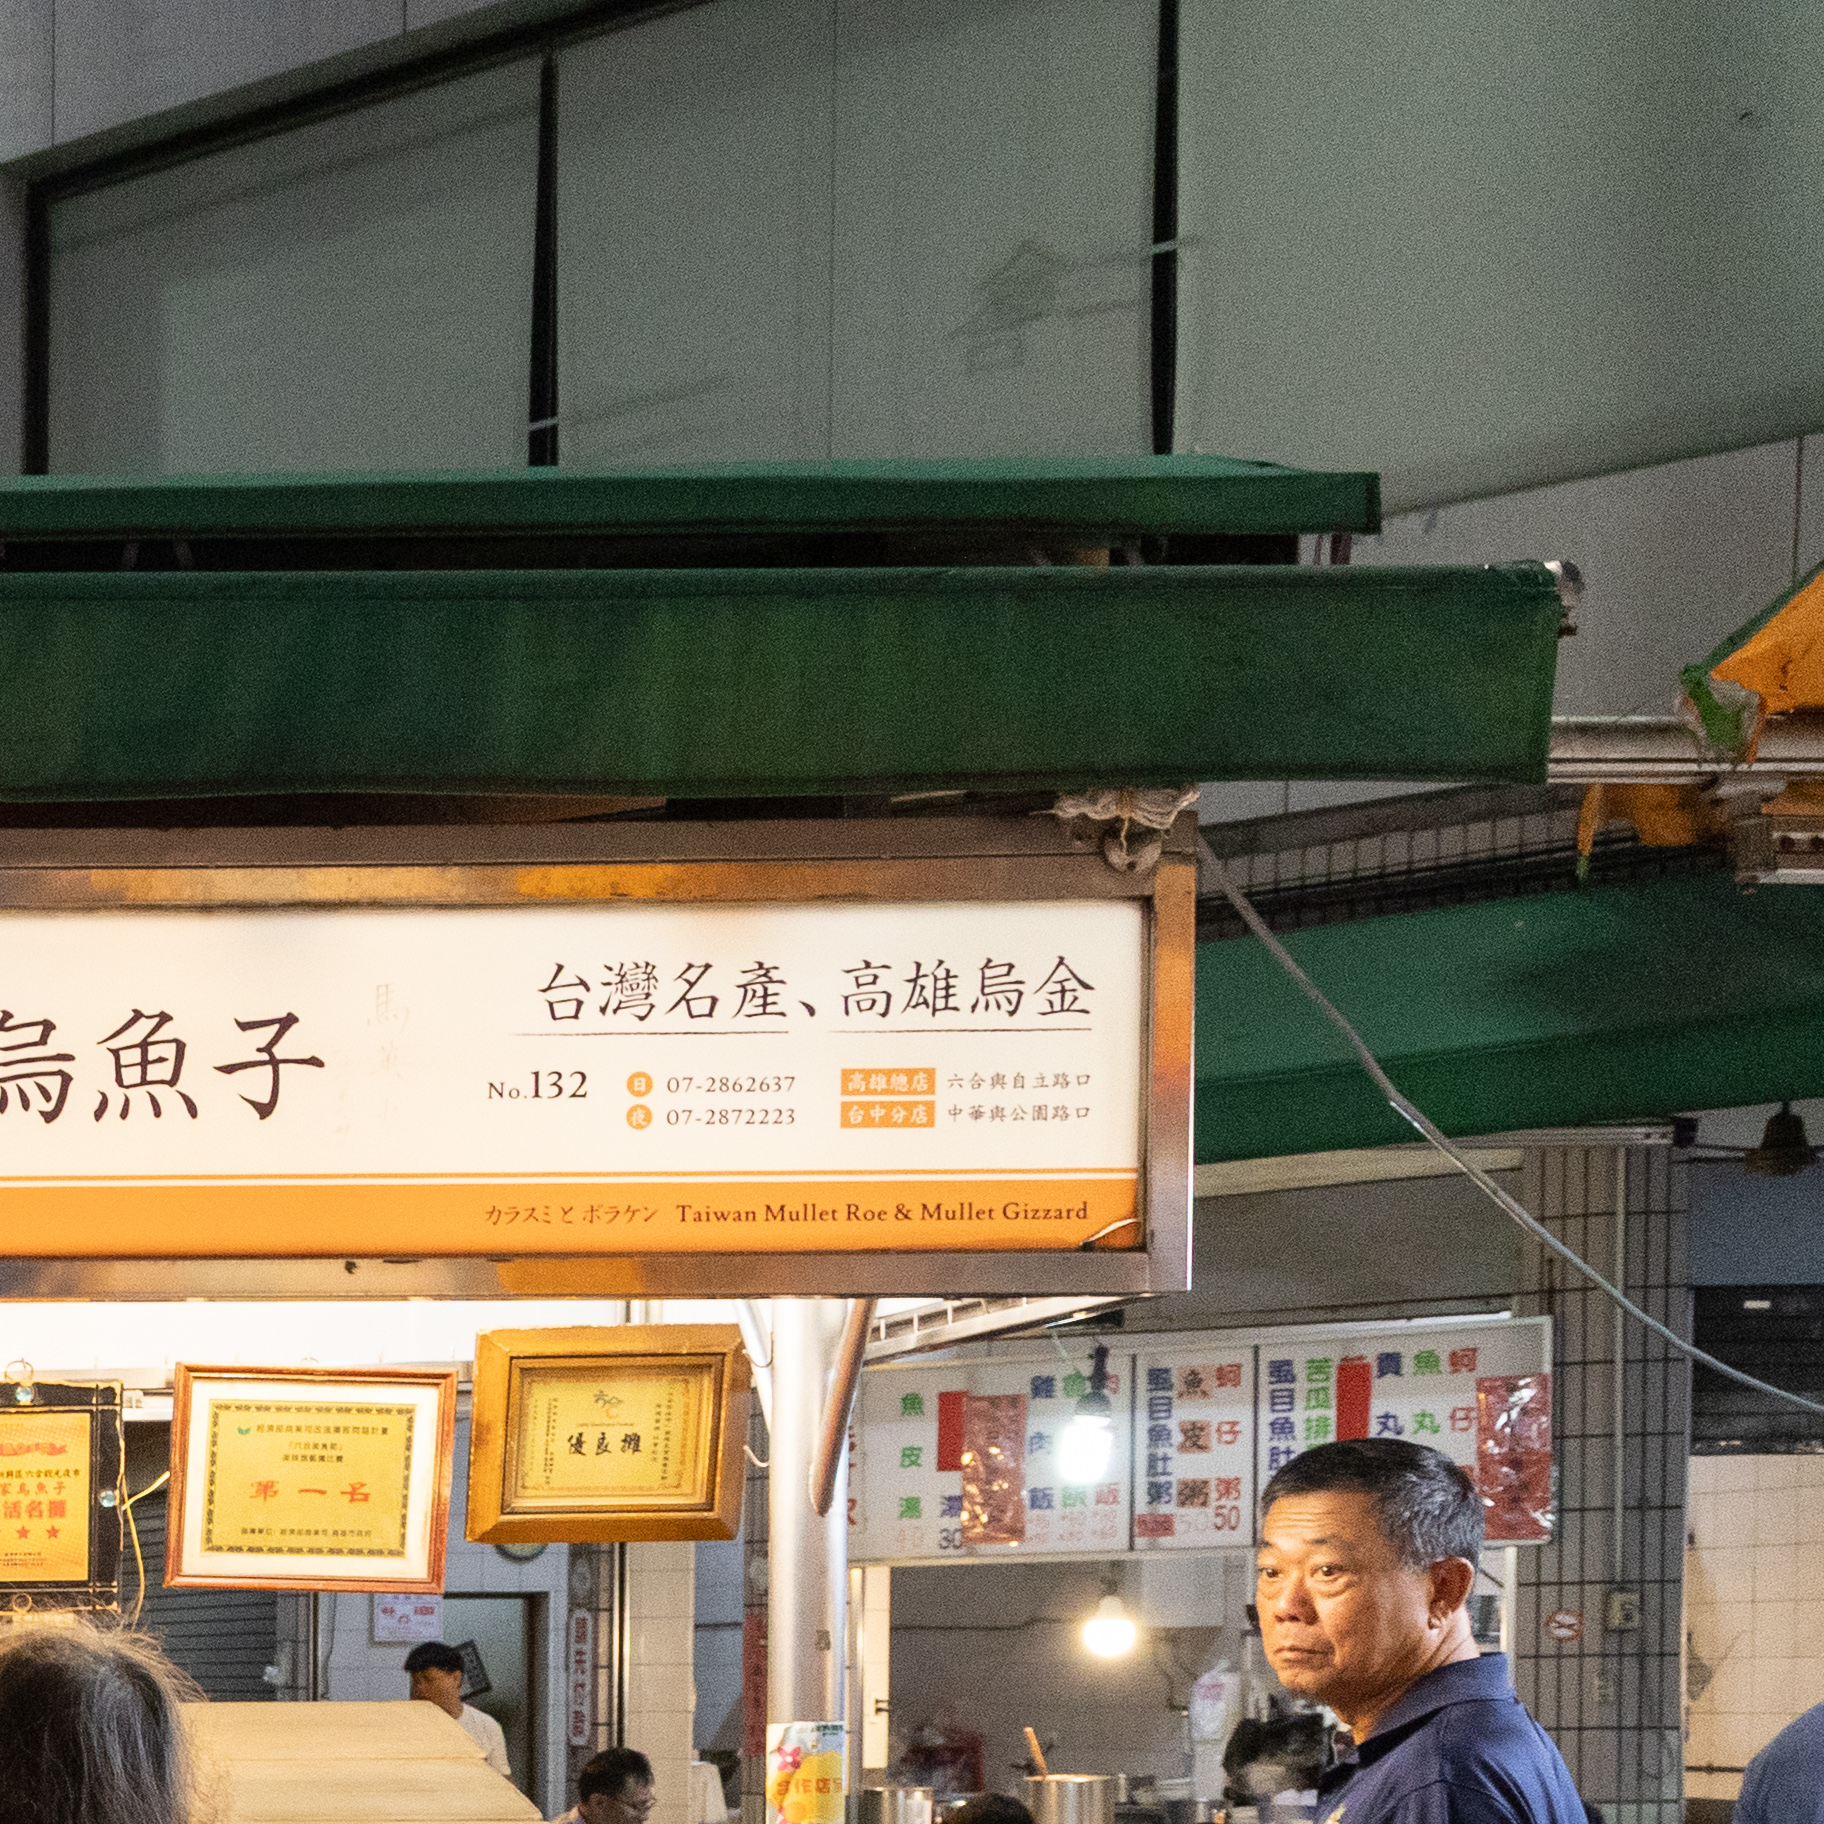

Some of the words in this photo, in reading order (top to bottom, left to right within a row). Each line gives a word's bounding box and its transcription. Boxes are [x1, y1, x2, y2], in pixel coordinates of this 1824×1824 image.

[538, 955, 1095, 1022] 台灣名產、高雄烏金
[666, 1075, 796, 1093] 07-2862637
[847, 1072, 929, 1093] 高雄總店
[947, 1072, 1091, 1090] 六合與自立路口
[631, 1108, 649, 1126] 夜
[665, 1107, 796, 1126] 07-2872223
[848, 1105, 929, 1126] 台中分店
[948, 1104, 1091, 1123] 中華與公園路口
[676, 1204, 757, 1223] Taiwan
[764, 1202, 838, 1223] Mullet
[846, 1203, 888, 1222] Roe
[893, 1203, 912, 1221] &
[920, 1201, 995, 1221] Mullet
[1001, 1200, 1088, 1221] Gizzard
[1304, 1357, 1332, 1447] 苦瓜排
[1268, 1358, 1297, 1475] 虱目魚肚
[567, 1431, 642, 1456] 優良攤
[1215, 1362, 1243, 1501] 蚵仔粥
[249, 1480, 371, 1503] 第一名
[1214, 1503, 1242, 1532] 50
